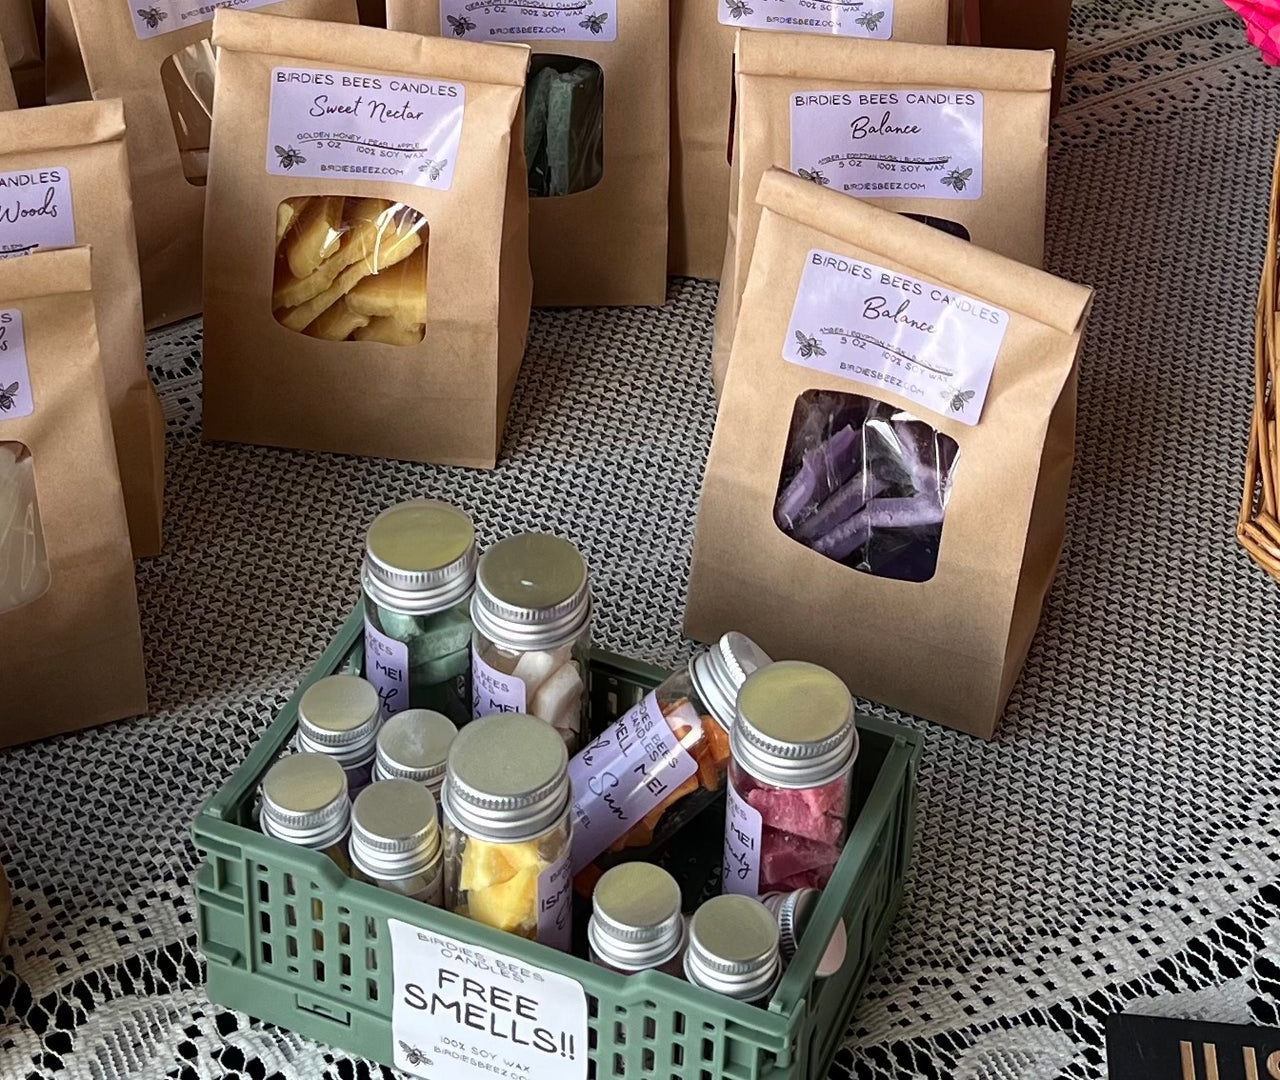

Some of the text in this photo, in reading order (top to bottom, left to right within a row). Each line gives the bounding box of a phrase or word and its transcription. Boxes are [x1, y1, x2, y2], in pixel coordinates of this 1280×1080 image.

[276, 71, 458, 97] BIRDIES BEES CANDLES
[795, 92, 975, 107] BIRDIES BEES CANDLES
[309, 95, 424, 123] Sweet Nectar
[851, 111, 921, 139] Balance
[812, 253, 1000, 324] BIRDIES BEES CANDLES
[863, 296, 936, 334] Balance
[651, 733, 681, 769] BEES
[588, 772, 628, 820] Sun
[417, 932, 545, 983] BIRDIES BEES
[441, 948, 525, 984] CANDLES
[438, 968, 538, 1021] FREE
[404, 983, 575, 1061] SMELLS!!
